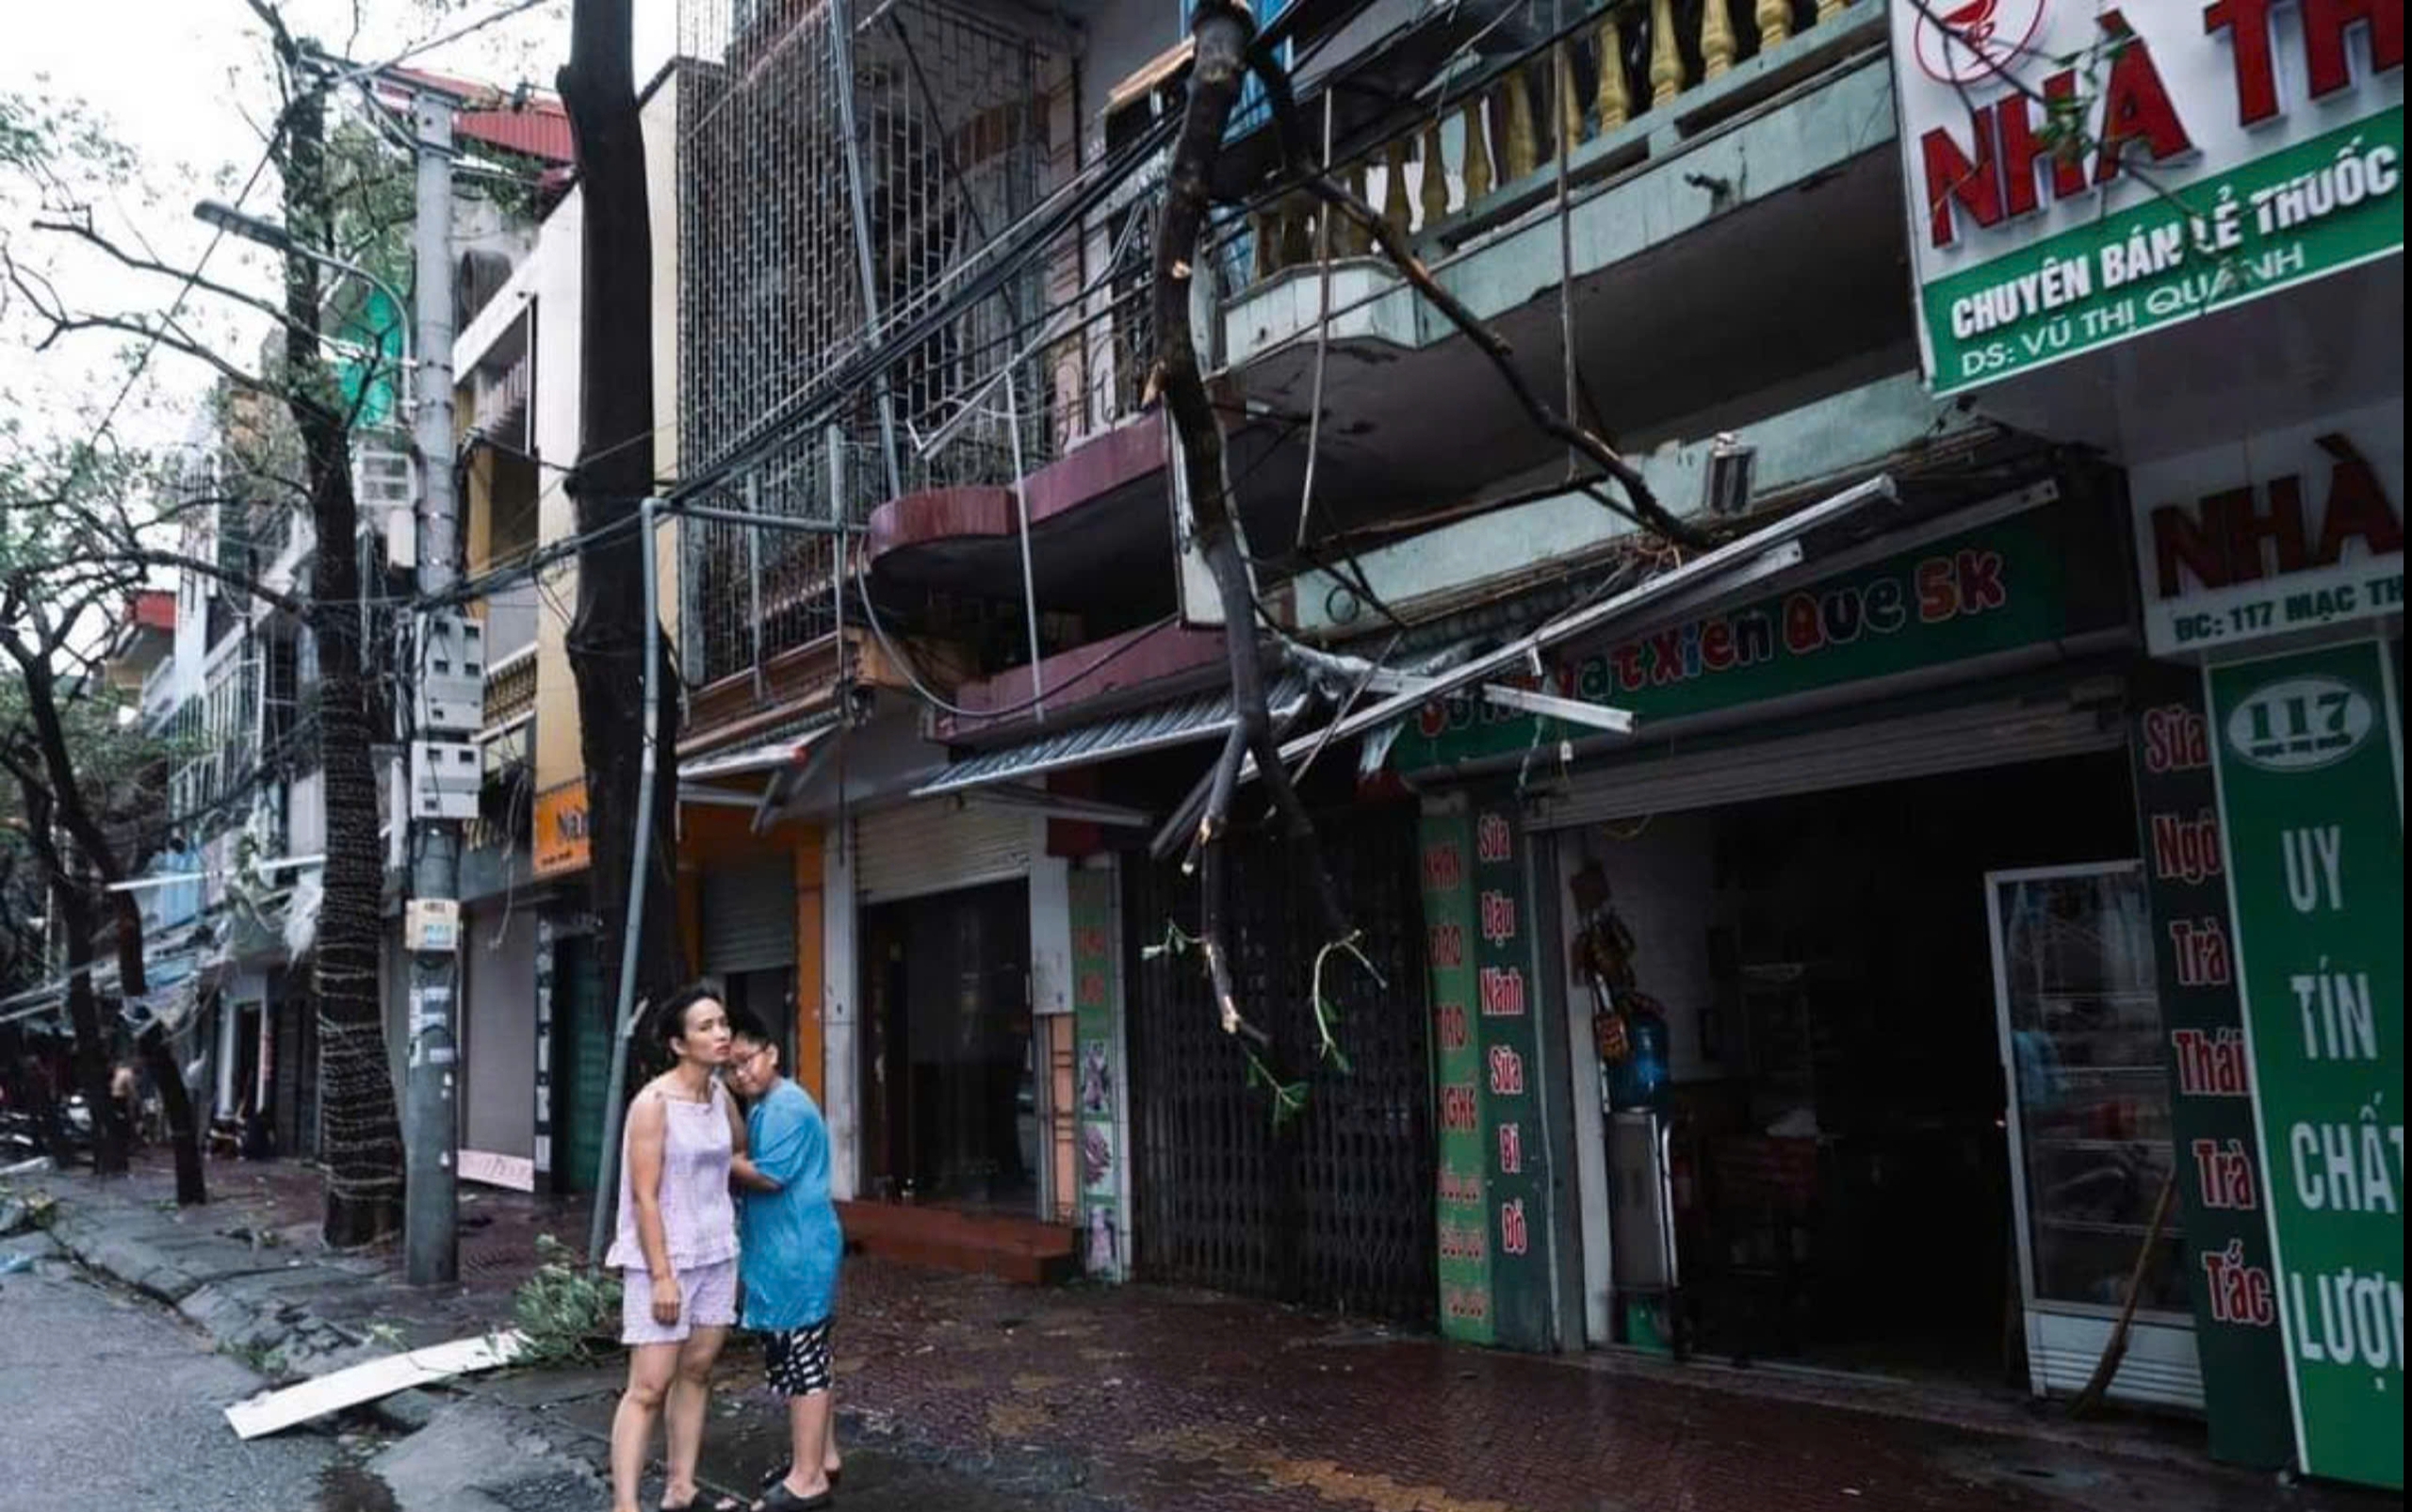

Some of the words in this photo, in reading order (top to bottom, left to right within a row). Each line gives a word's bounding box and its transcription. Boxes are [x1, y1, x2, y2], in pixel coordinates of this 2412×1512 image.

[1920, 8, 2192, 248] NHÀ
[1952, 252, 2092, 339] CHUYÊN
[2099, 224, 2183, 286] BÁN
[2248, 135, 2400, 236] THUỐC
[1961, 345, 2015, 377] DS:
[2021, 314, 2072, 357] VŨ
[2081, 299, 2137, 332] THỊ
[2152, 432, 2404, 600] NHÀ
[2229, 601, 2273, 631] 117
[2285, 585, 2355, 622] MẠC
[2144, 705, 2209, 773] Sữa
[2248, 691, 2351, 741] 117
[2153, 811, 2222, 883] Ngô
[2282, 825, 2342, 912] UY
[2171, 918, 2230, 985] Trà
[2290, 955, 2378, 1060] TÍN
[2192, 1138, 2257, 1211] Trà
[2202, 1239, 2274, 1326] Tắc
